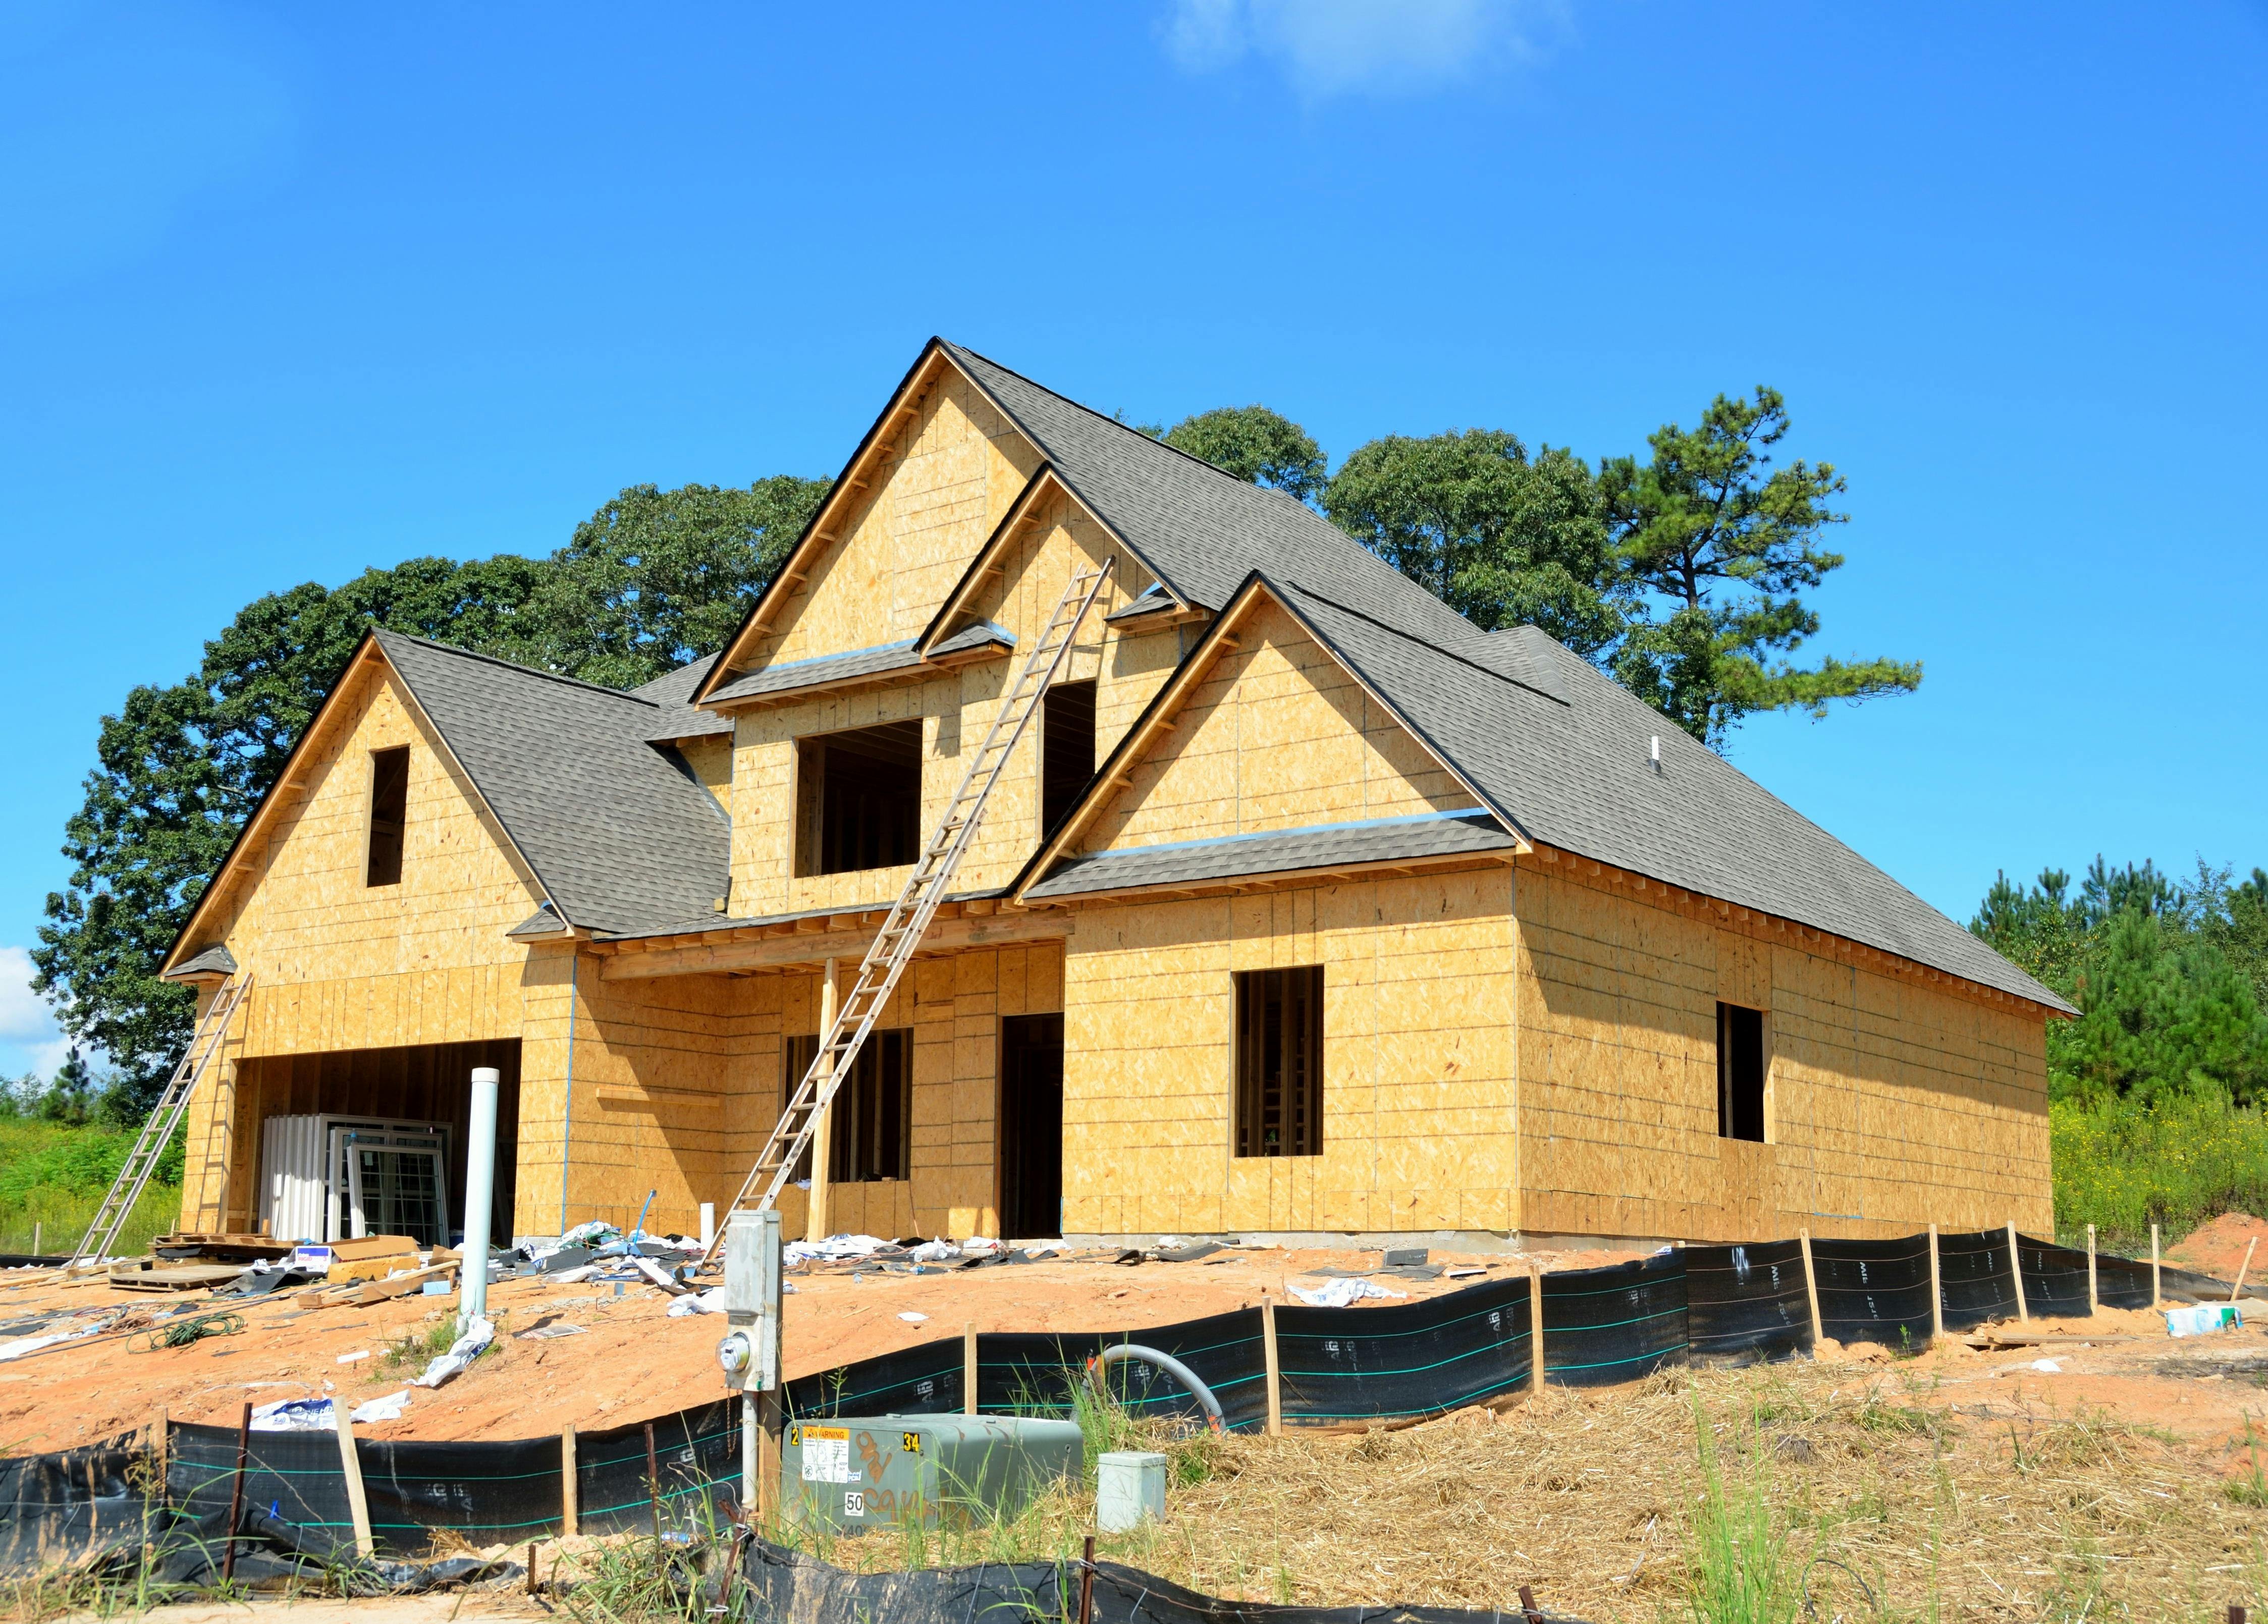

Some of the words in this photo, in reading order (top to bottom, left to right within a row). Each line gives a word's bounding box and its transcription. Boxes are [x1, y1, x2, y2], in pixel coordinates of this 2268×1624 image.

[791, 1428, 799, 1445] 2
[816, 1430, 844, 1439] WARNING
[904, 1433, 919, 1452] 34
[846, 1494, 862, 1511] 50
